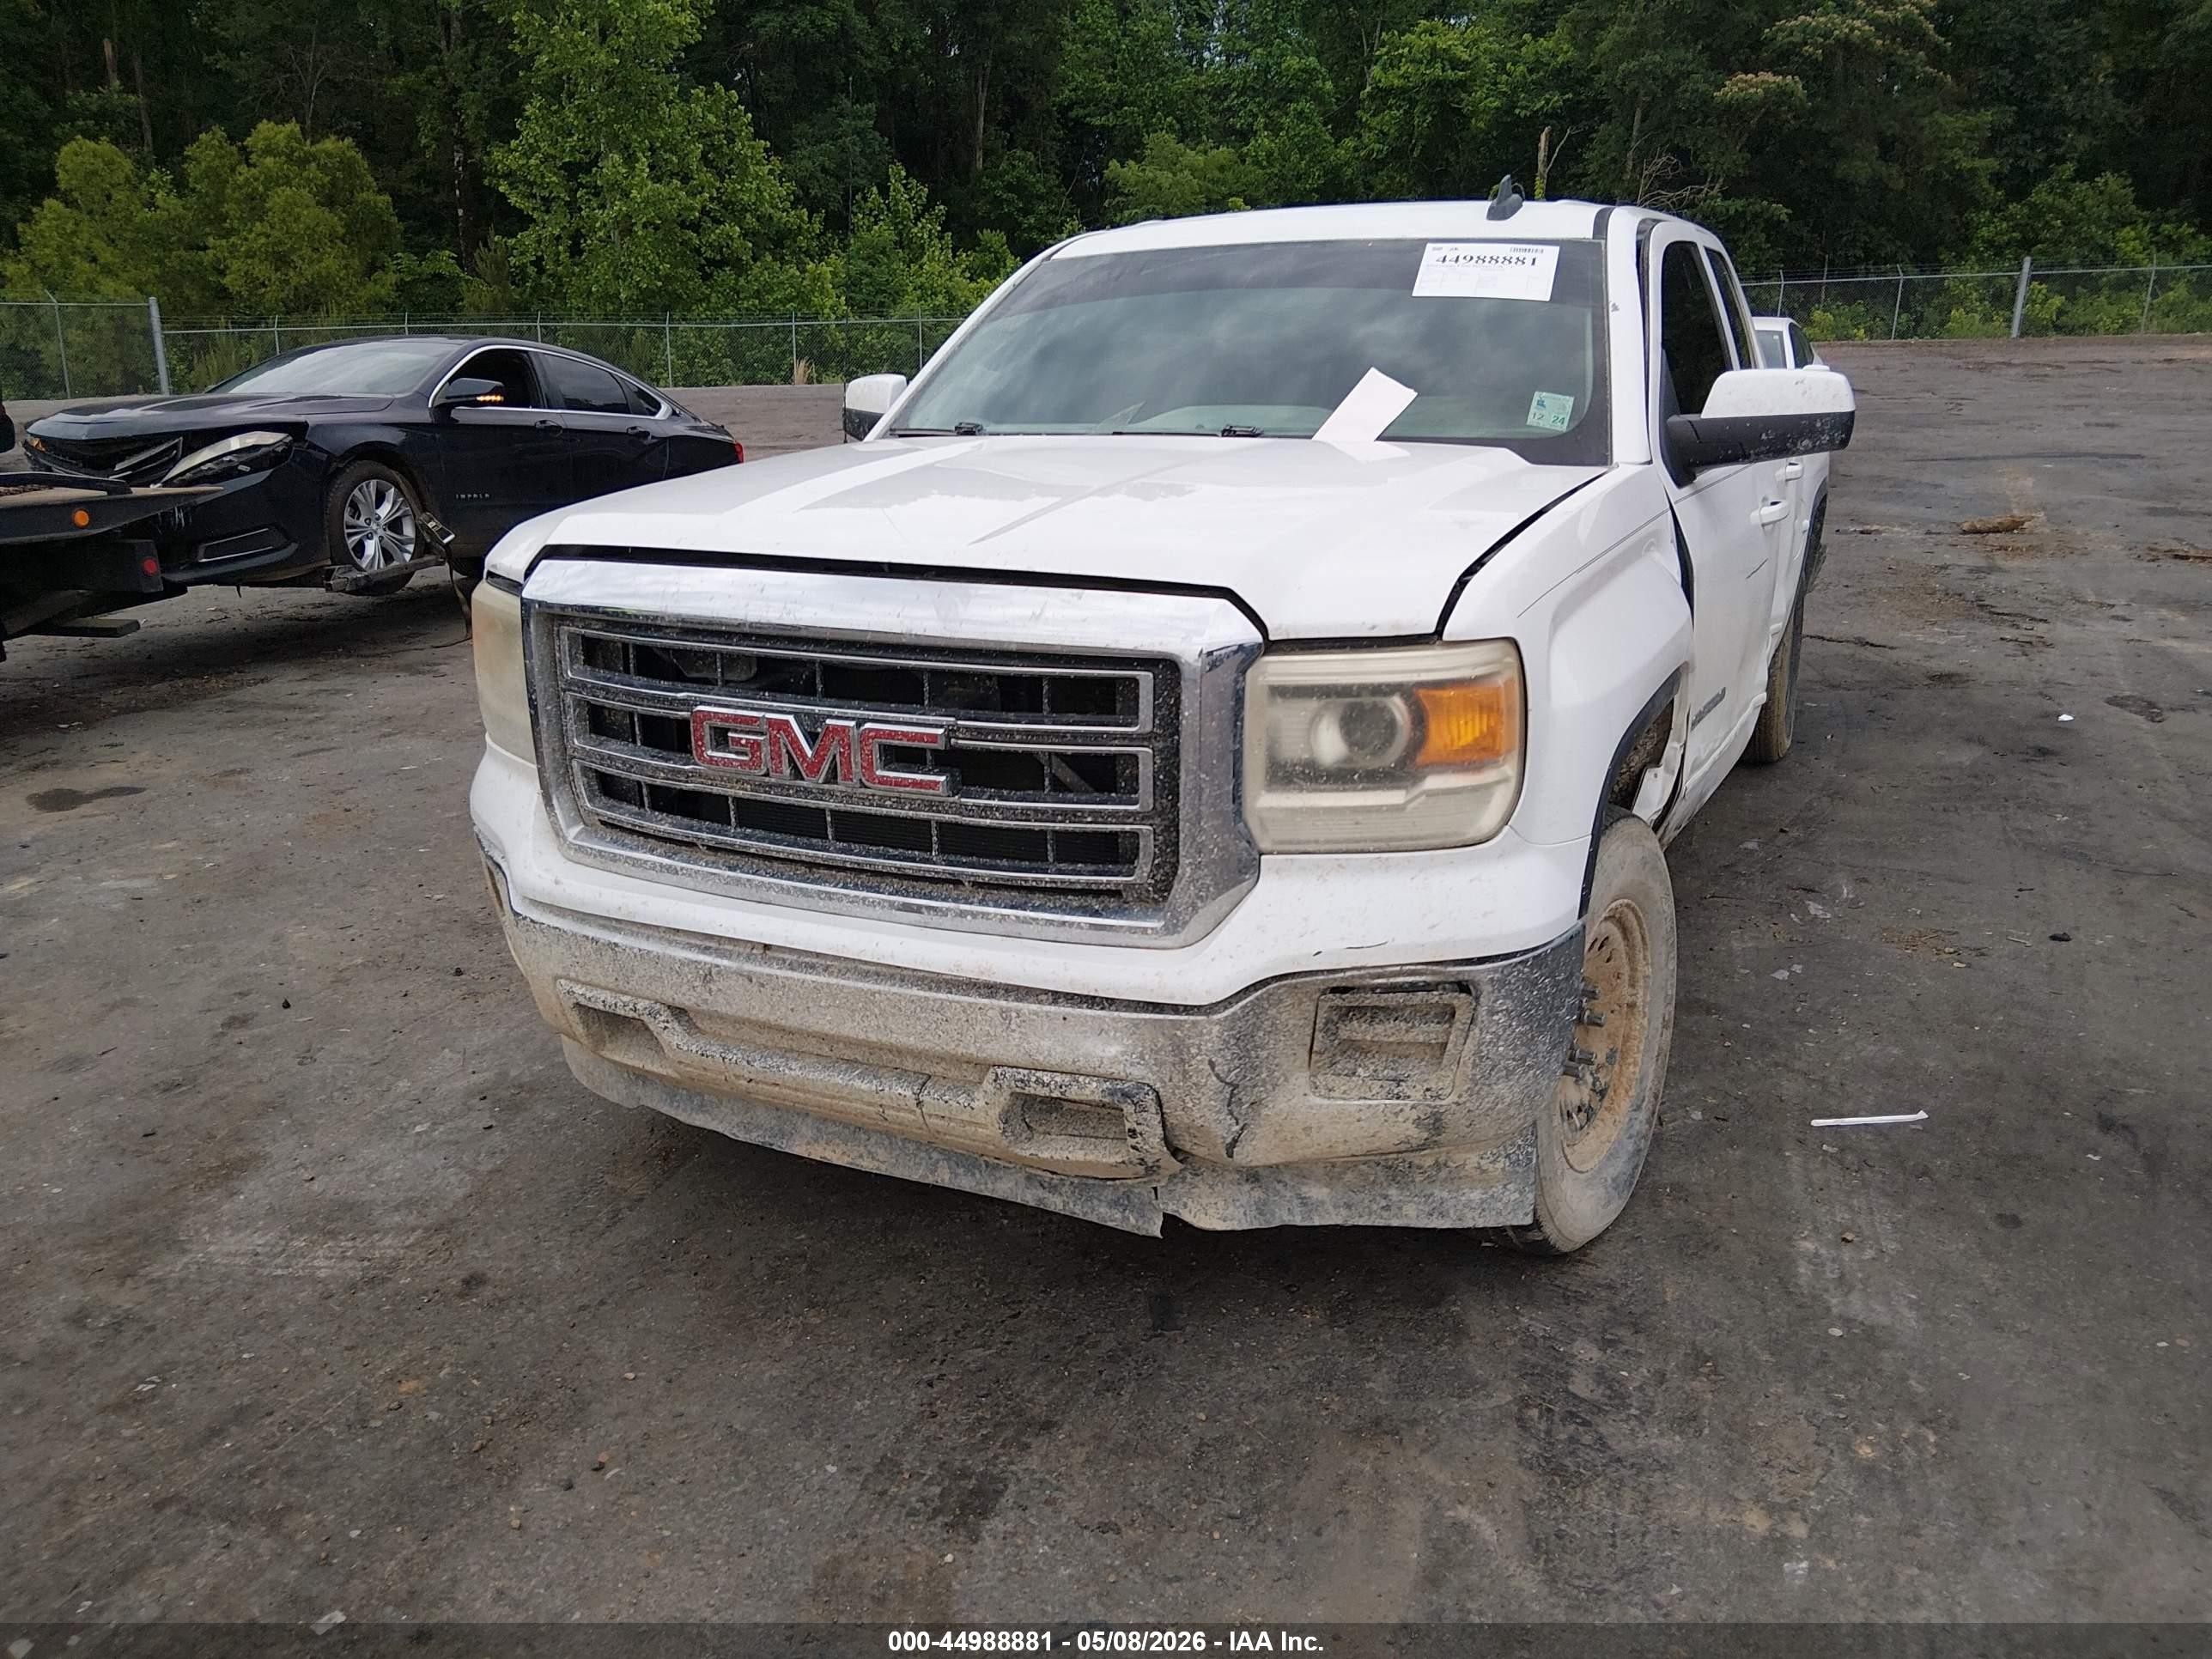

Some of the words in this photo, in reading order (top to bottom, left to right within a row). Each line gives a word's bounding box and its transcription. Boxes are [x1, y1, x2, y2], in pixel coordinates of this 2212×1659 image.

[1436, 254, 1537, 267] 44988881
[1552, 415, 1565, 425] 24
[690, 706, 946, 795] GMC
